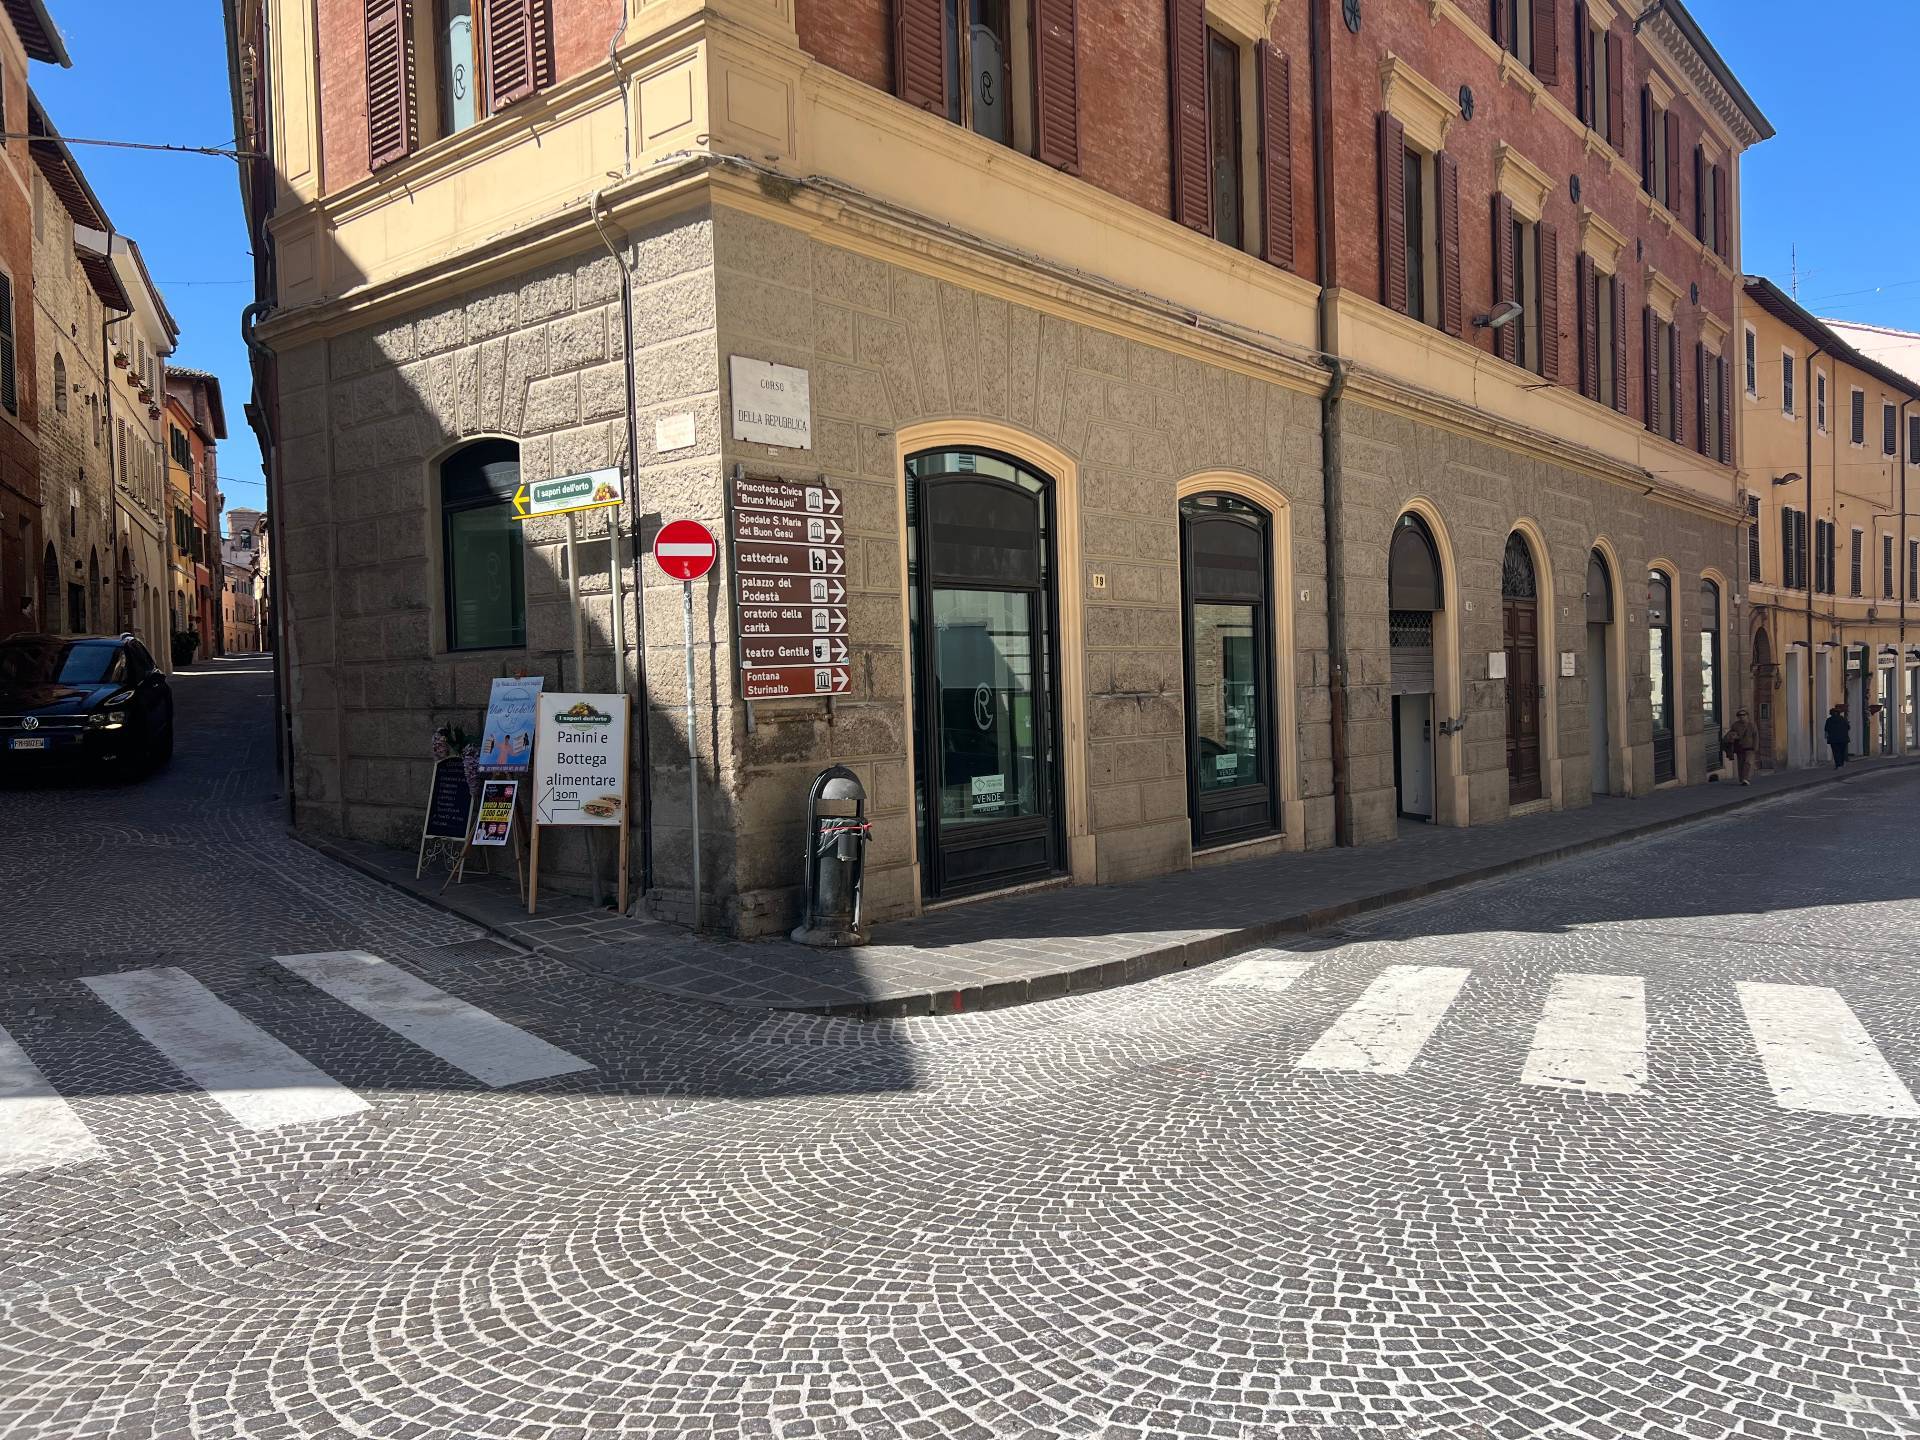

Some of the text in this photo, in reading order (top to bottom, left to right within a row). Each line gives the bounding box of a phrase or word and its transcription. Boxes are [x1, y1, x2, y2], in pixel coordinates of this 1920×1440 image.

[760, 379, 785, 392] CORSO
[738, 409, 807, 432] DELLA REPUBBLICA
[537, 482, 589, 498] I sapori dell'orto
[736, 480, 803, 497] Pinacoteca Civica
[737, 492, 764, 504] "Bruno
[739, 513, 802, 527] Spedale S. Maria
[739, 526, 794, 538] del Buon Gesù
[740, 552, 789, 564] cattedrale
[742, 577, 792, 588] palazzo del
[742, 590, 780, 602] Podestà
[744, 609, 803, 618] oratorio della
[744, 622, 770, 632] carità
[746, 646, 810, 658] teatro Gentile
[746, 672, 780, 682] Fontana
[748, 684, 789, 694] Sturinalto
[558, 731, 608, 744] Panini e
[558, 752, 607, 768] Bottega
[546, 773, 616, 786] alimentare
[556, 791, 578, 800] 30m
[977, 793, 1001, 803] VENDE
